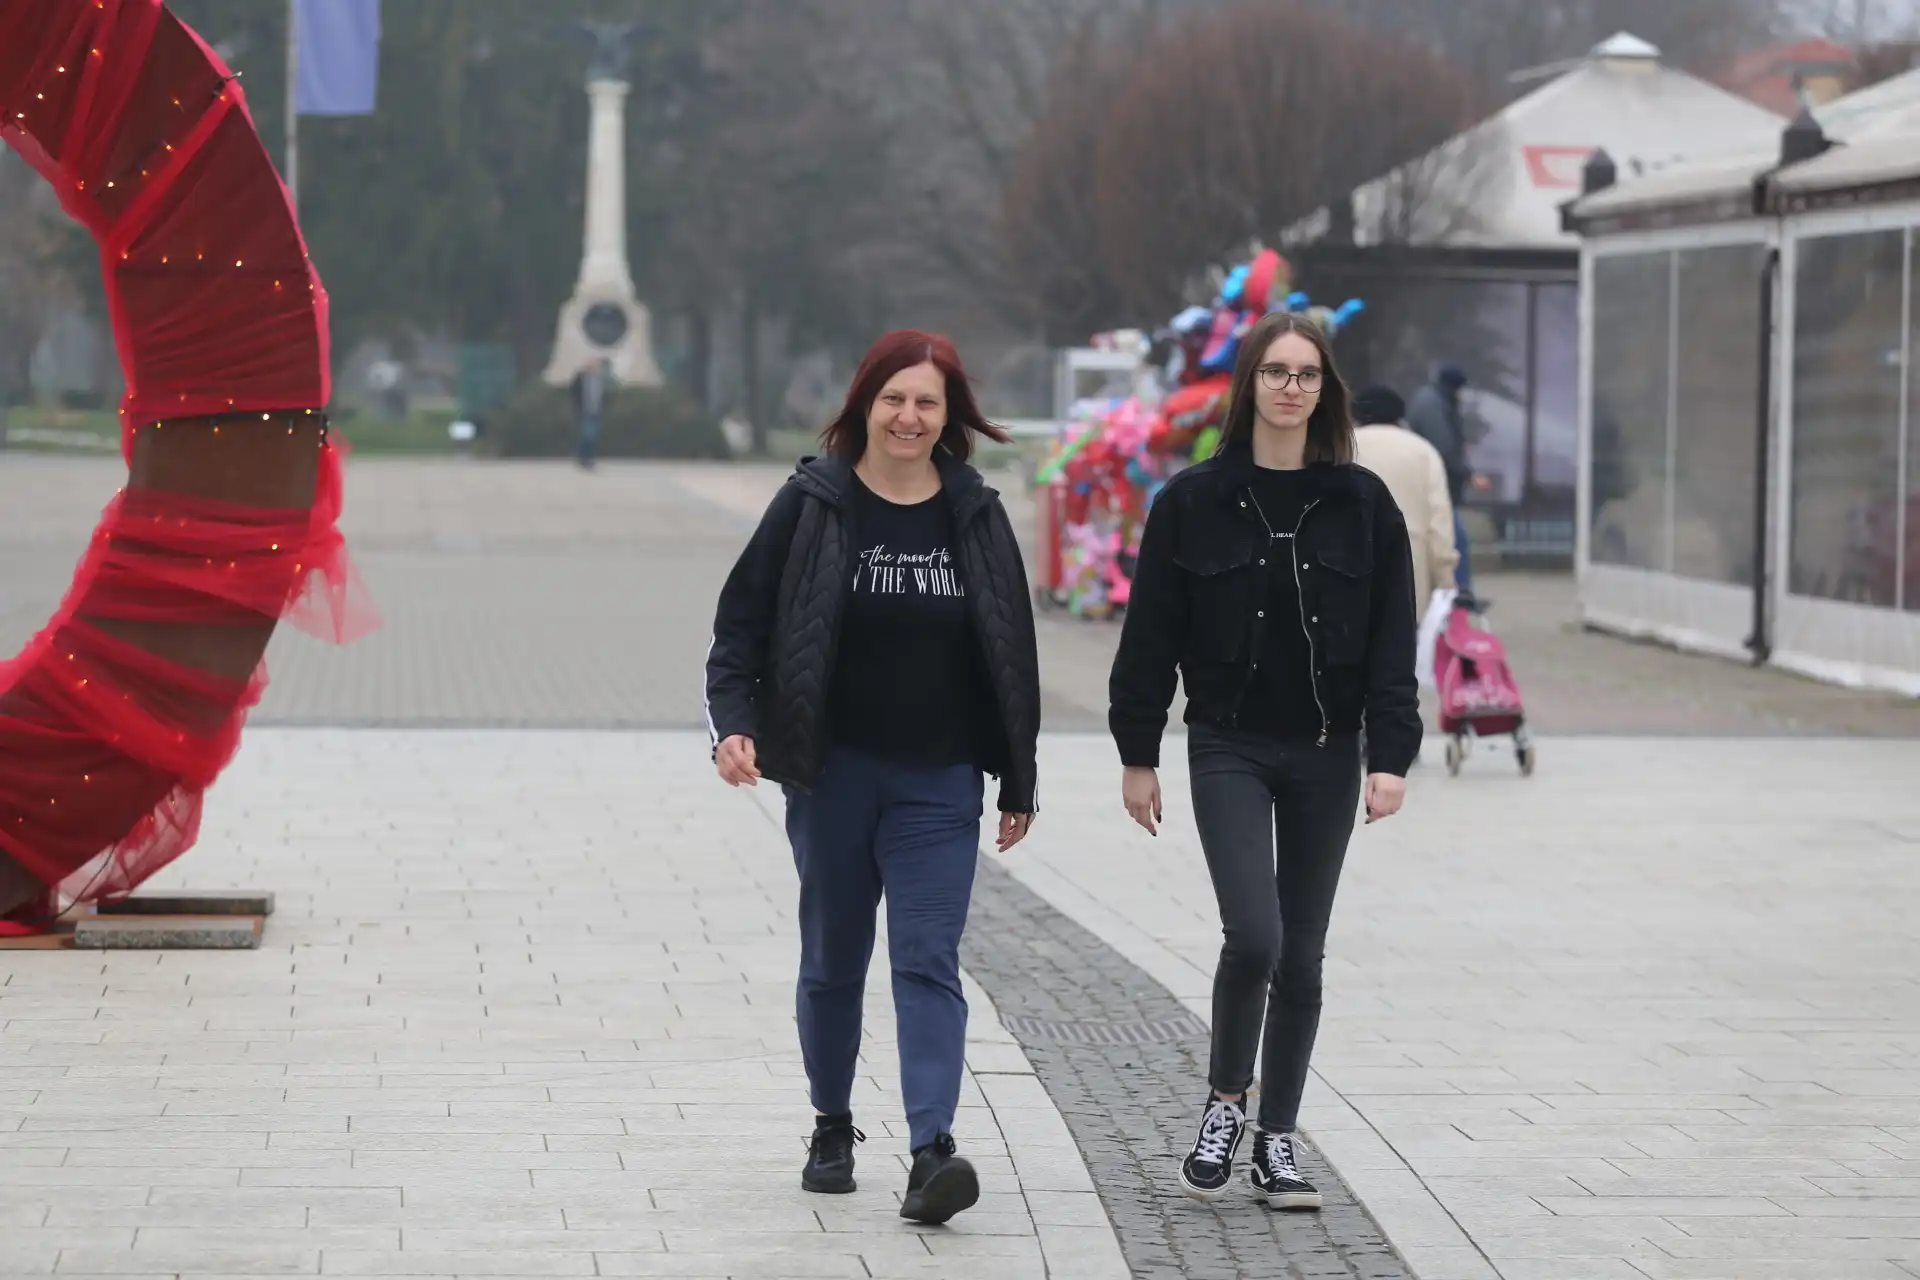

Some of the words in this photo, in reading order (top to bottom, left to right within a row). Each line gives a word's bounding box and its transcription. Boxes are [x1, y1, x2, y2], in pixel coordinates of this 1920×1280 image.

[864, 544, 895, 567] the
[897, 547, 936, 567] mood
[938, 547, 953, 570] to
[870, 566, 905, 593] THE
